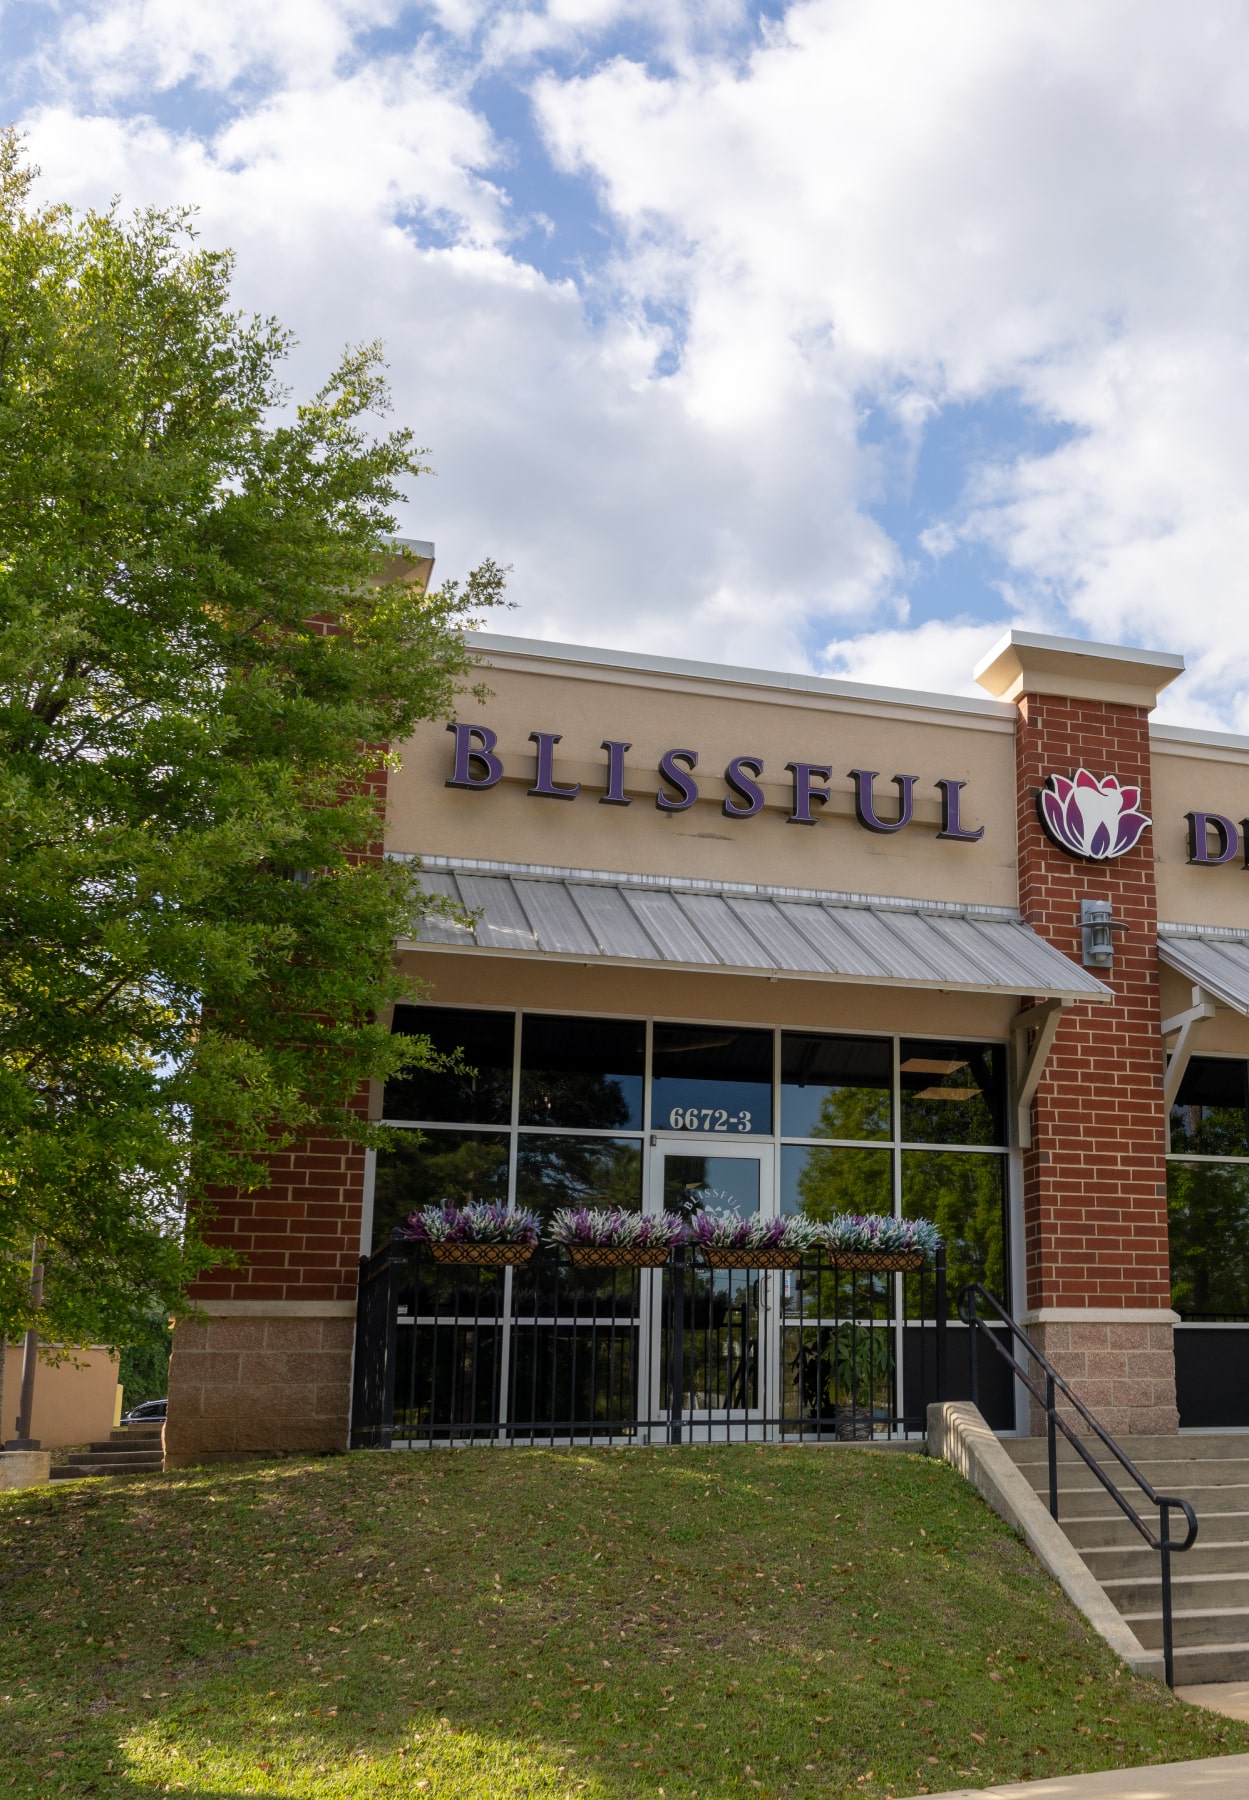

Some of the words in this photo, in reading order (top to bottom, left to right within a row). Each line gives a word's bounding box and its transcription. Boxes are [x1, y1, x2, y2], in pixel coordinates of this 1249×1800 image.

[444, 722, 985, 842] BLISSFUL
[669, 1107, 752, 1132] 6672-3
[683, 1188, 741, 1211] BLISSFUL
